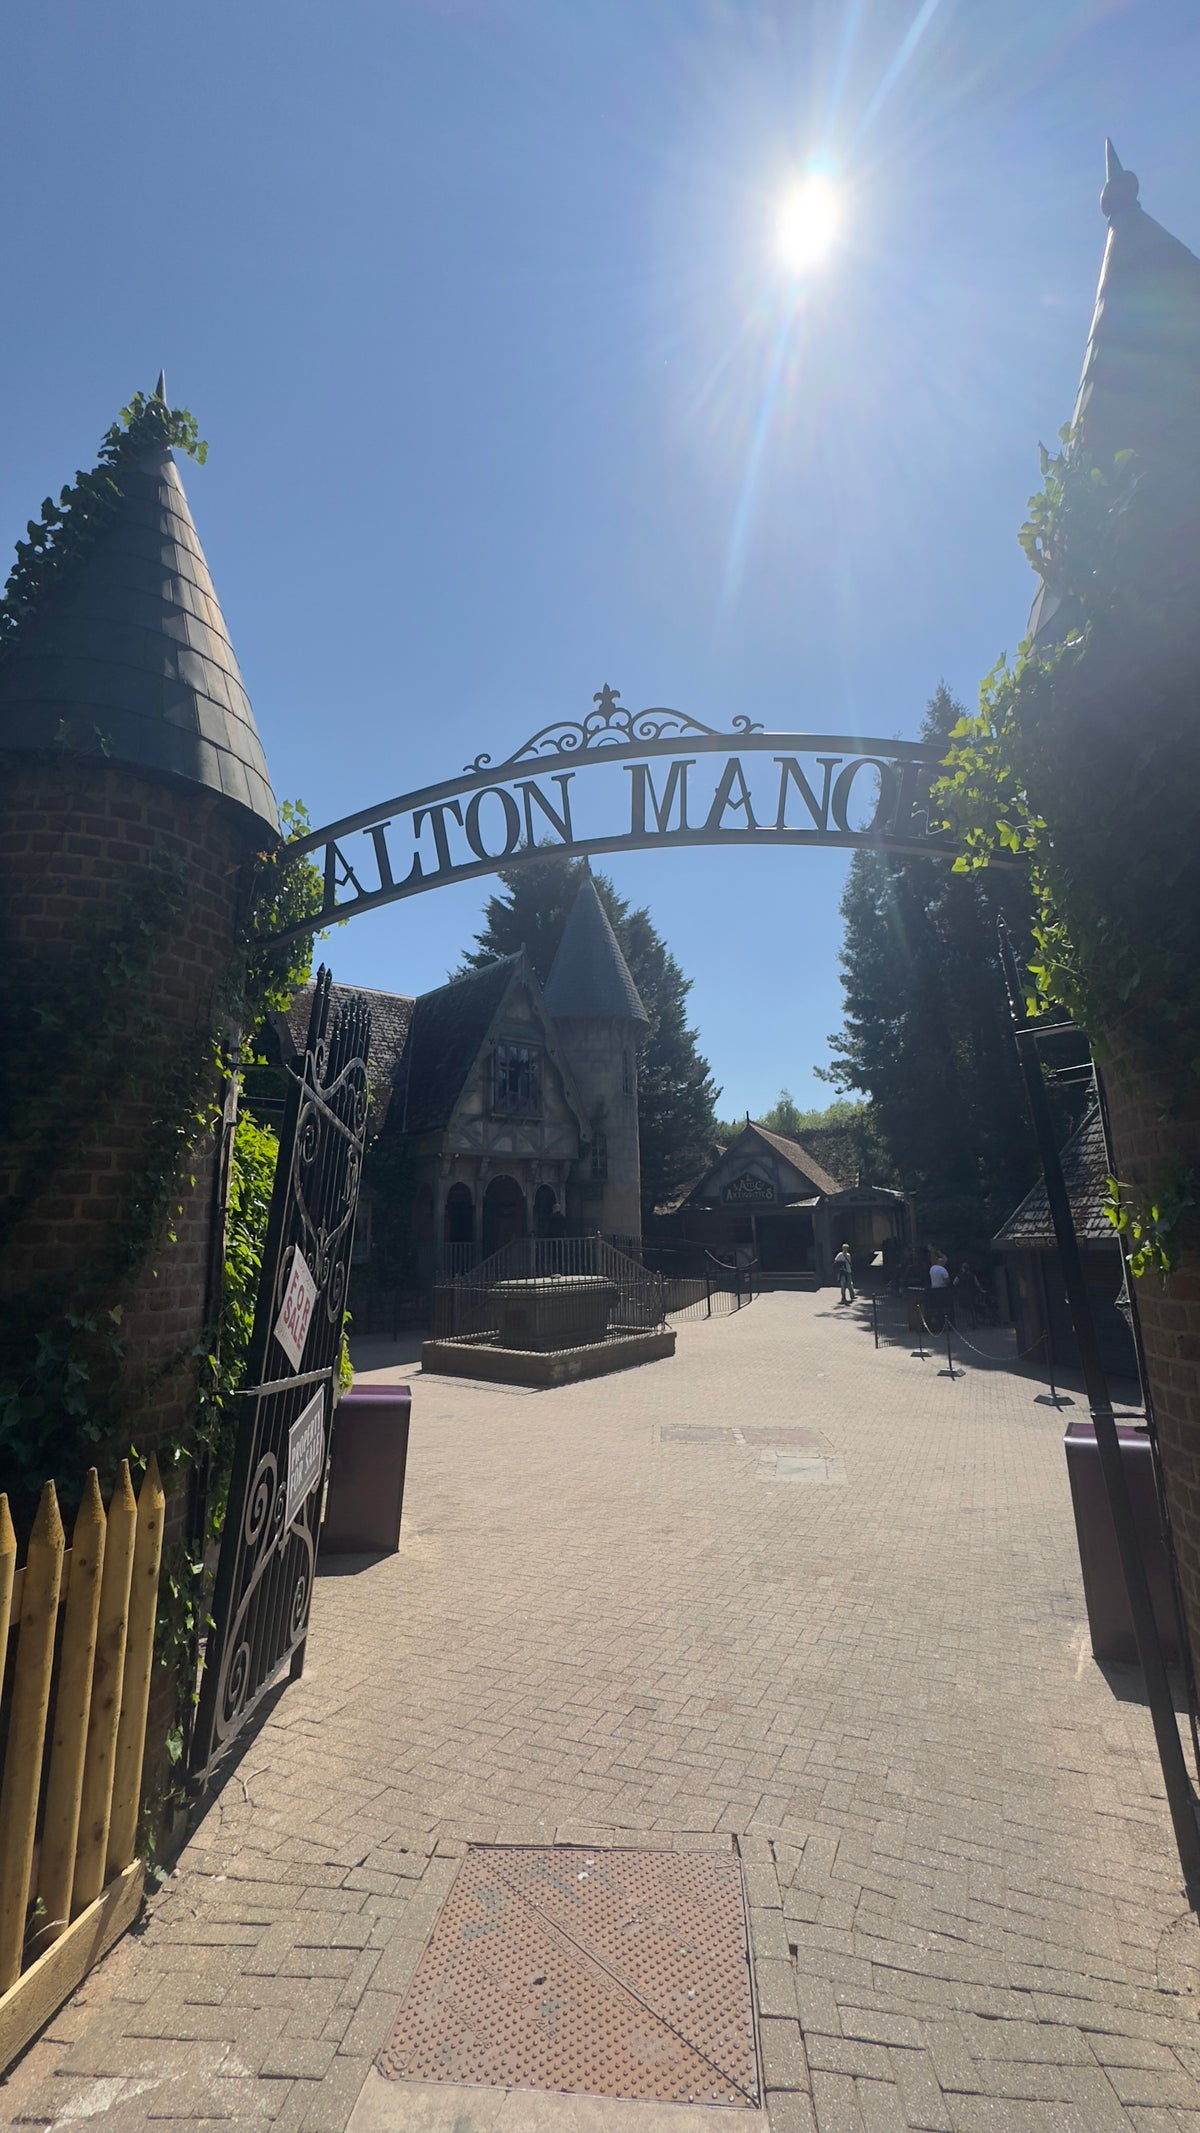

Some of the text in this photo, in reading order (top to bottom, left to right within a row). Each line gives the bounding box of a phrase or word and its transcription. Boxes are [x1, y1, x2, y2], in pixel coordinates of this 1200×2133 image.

[311, 772, 576, 918] ALTON
[284, 1296, 306, 1351] SALE
[290, 1269, 310, 1327] FOR
[289, 1460, 304, 1500] FOR
[305, 1432, 321, 1475] SALE
[291, 1408, 321, 1471] PROPERTY
